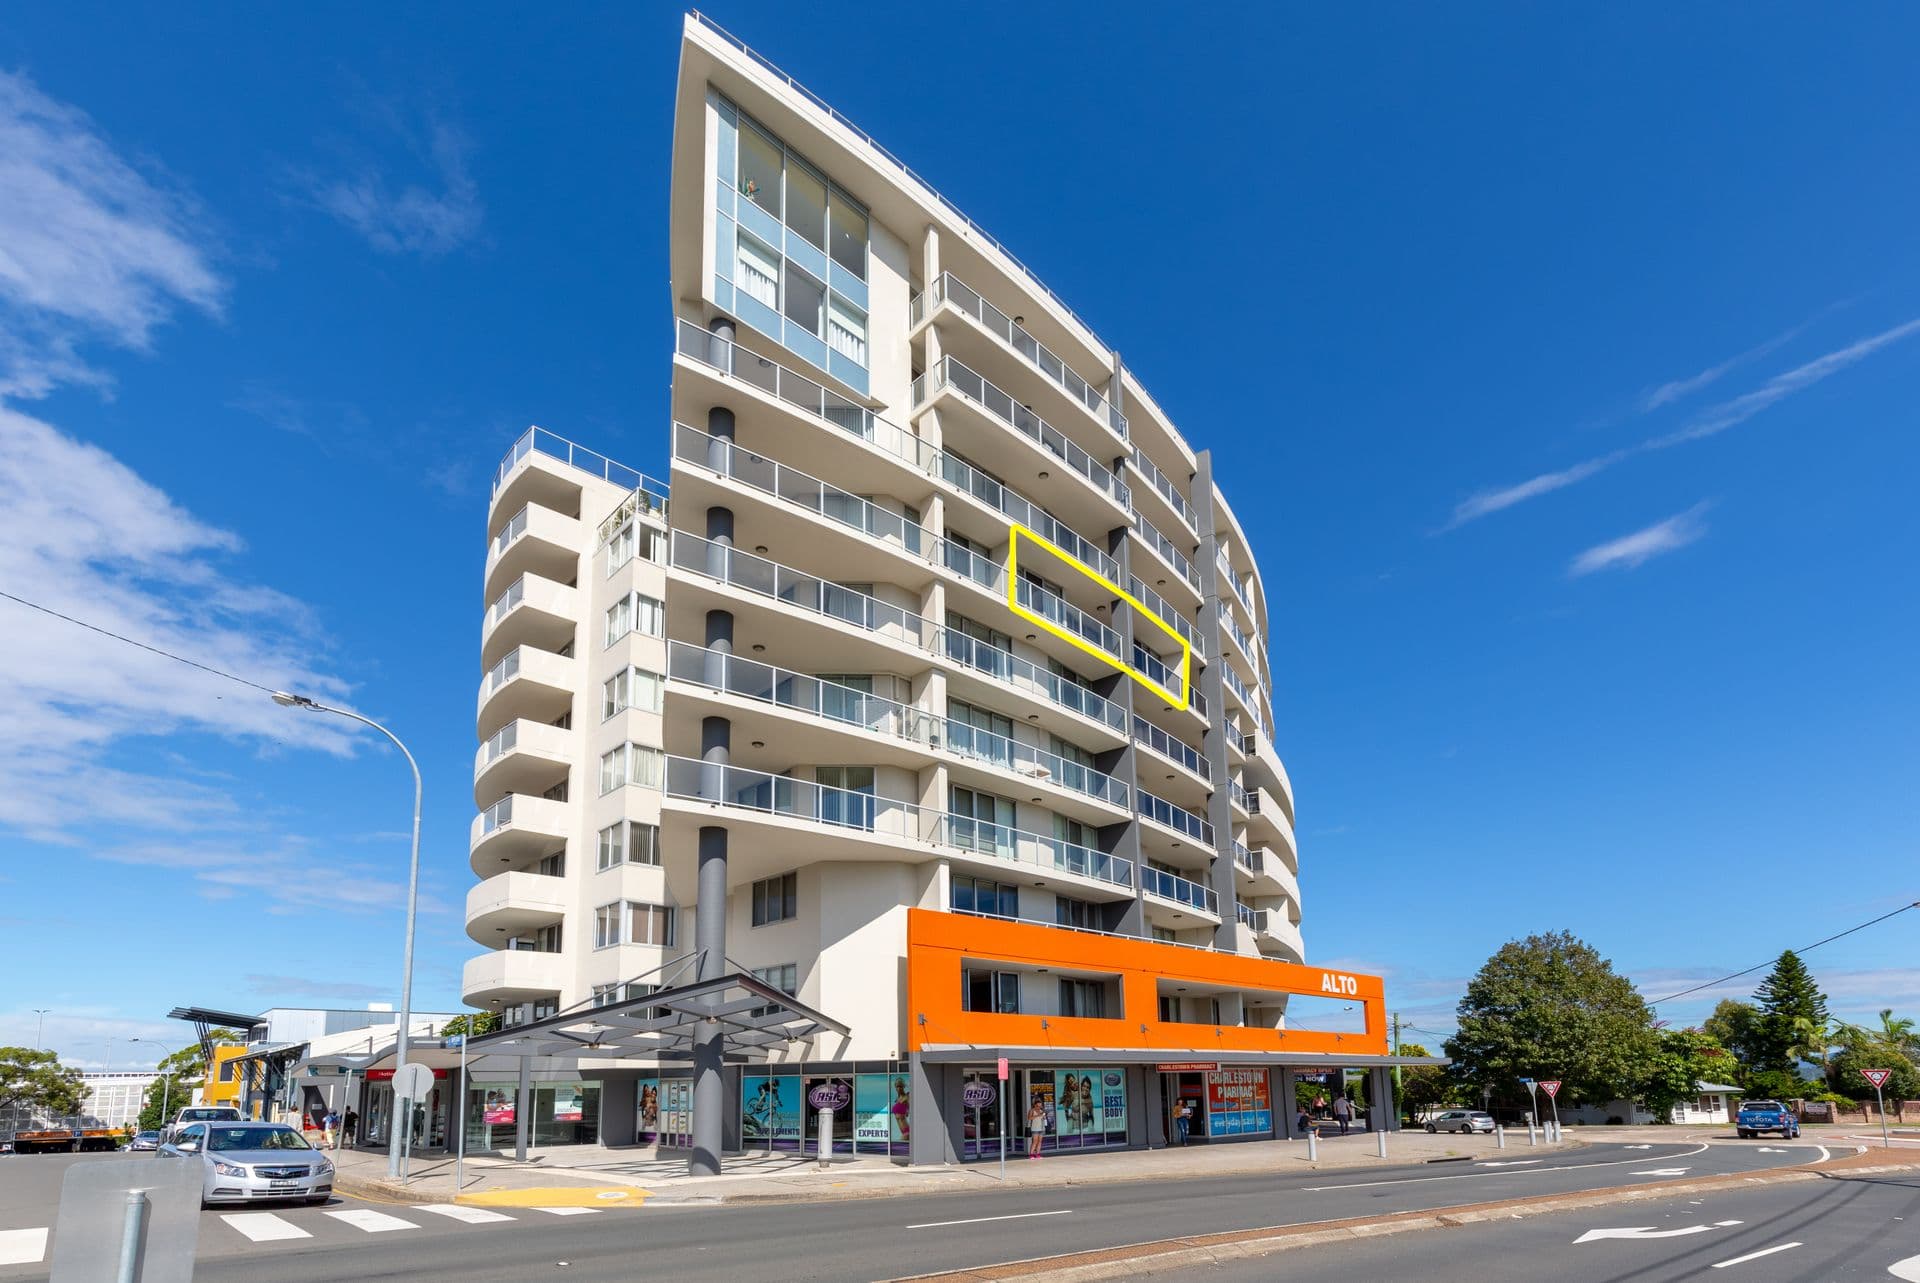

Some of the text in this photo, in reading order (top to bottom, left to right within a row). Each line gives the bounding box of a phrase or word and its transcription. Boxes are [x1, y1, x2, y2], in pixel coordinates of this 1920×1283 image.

[1321, 972, 1358, 995] ALTO
[1104, 1095, 1123, 1107] BEST
[1104, 1107, 1124, 1118] BODY
[756, 1127, 800, 1136] SUPLEMENTS
[858, 1129, 889, 1138] EXPERTS
